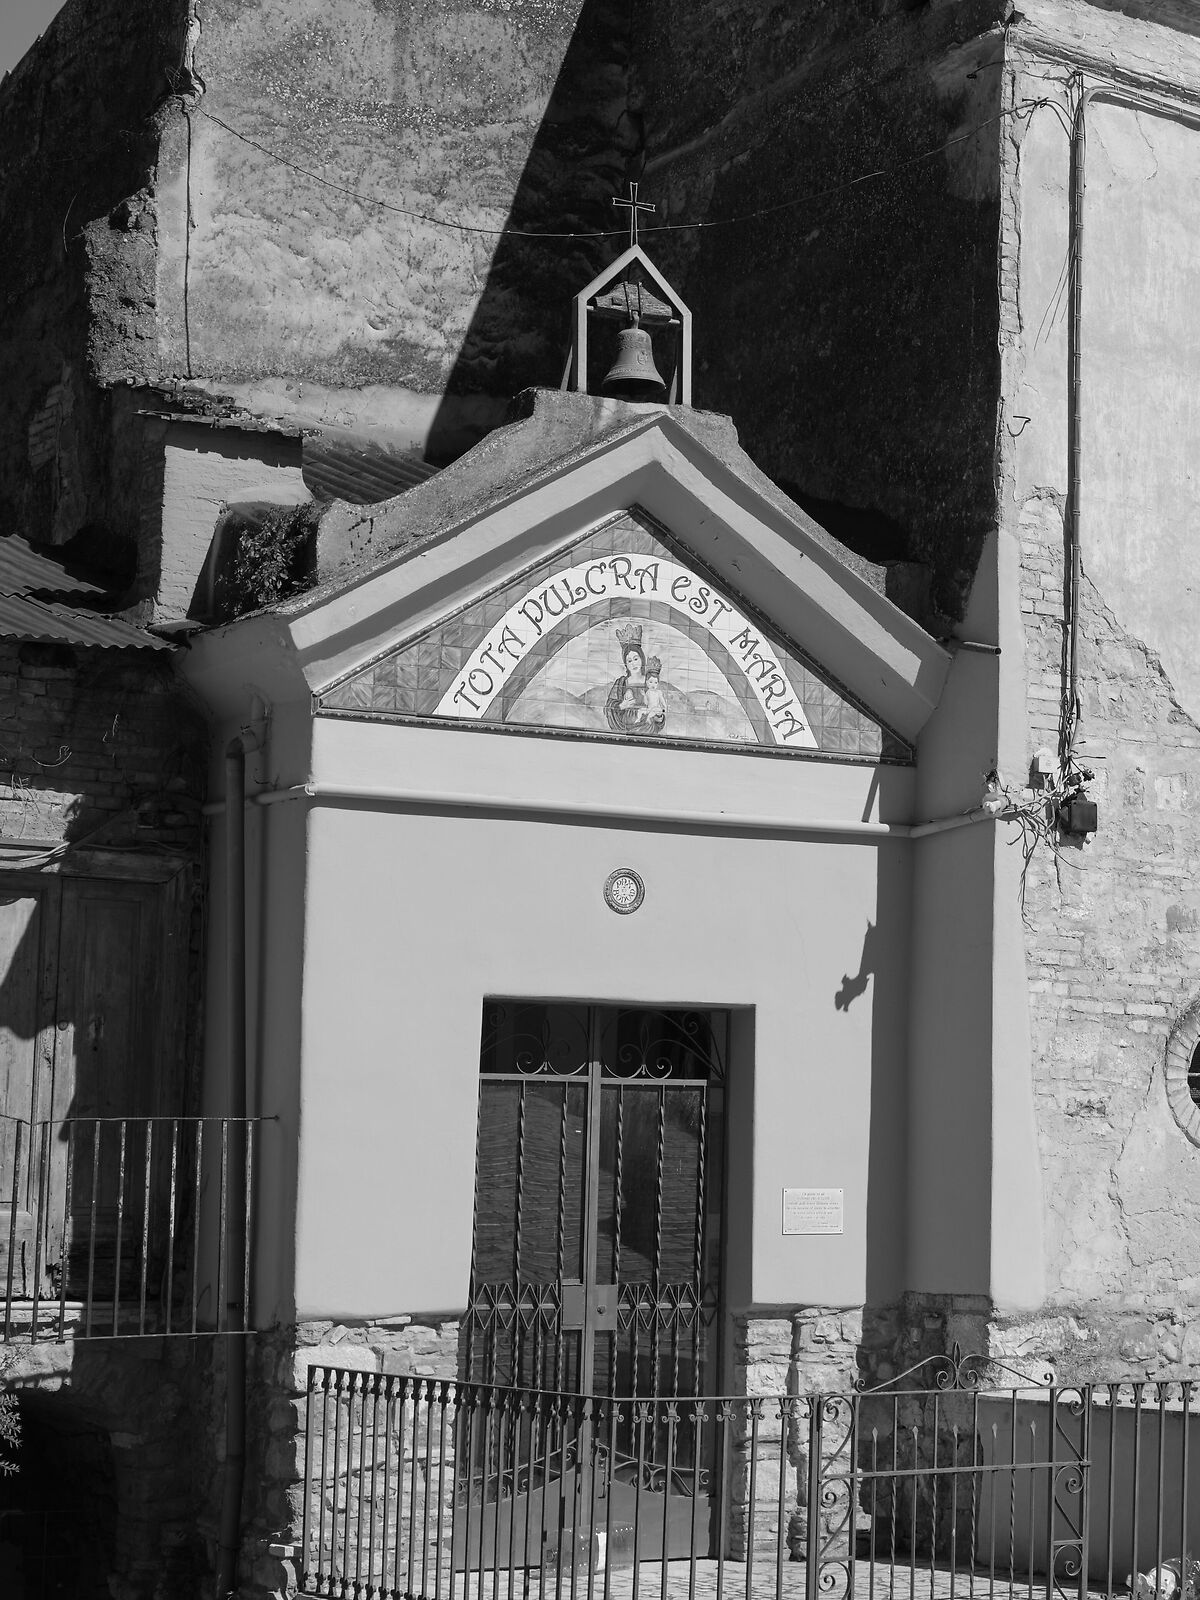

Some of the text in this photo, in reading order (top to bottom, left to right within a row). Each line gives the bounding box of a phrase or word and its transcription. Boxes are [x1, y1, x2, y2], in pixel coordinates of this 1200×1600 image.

[453, 625, 526, 712] TOTA
[518, 556, 660, 636] PULCRA
[729, 626, 806, 741] MARIA
